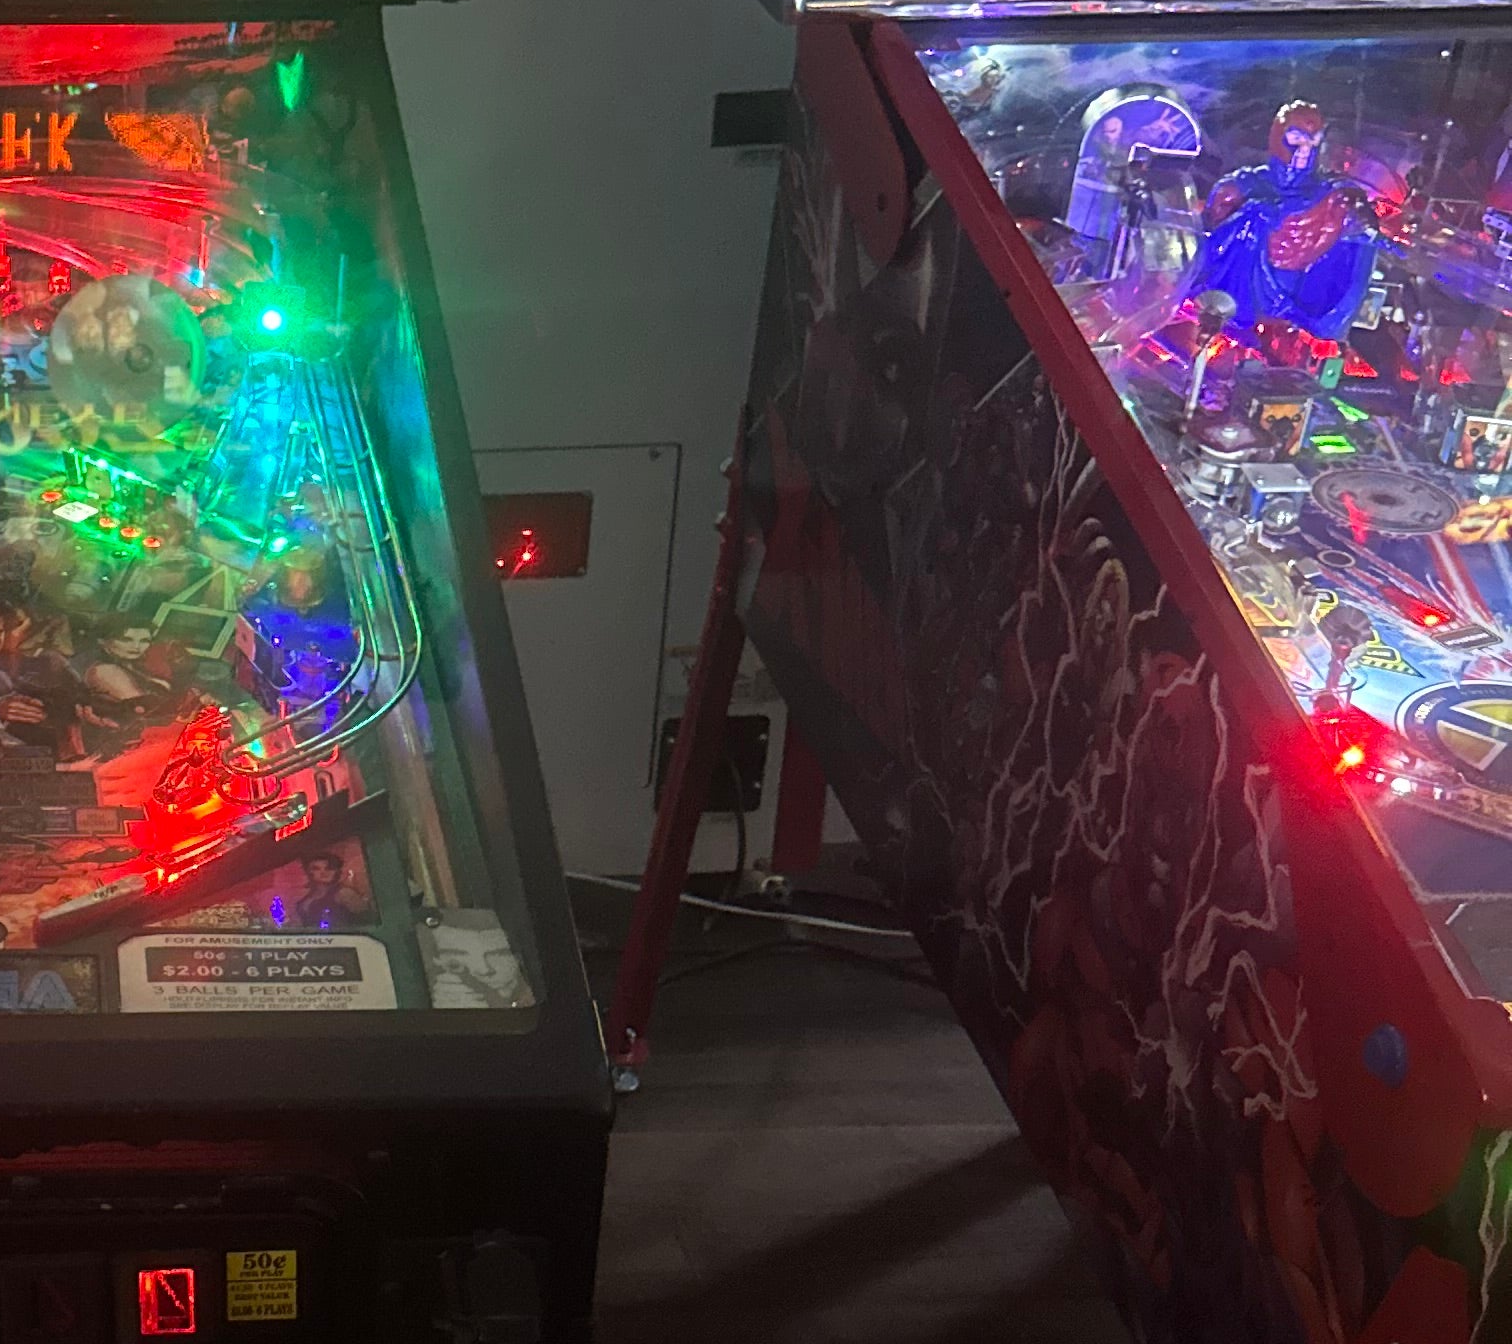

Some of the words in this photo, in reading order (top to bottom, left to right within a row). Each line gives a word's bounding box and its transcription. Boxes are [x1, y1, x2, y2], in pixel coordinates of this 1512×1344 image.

[164, 937, 195, 945] FOR
[198, 936, 291, 945] AMUSEMENT
[296, 937, 335, 945] ONLY
[261, 951, 309, 961] PLAY
[162, 965, 224, 977] $2.00
[267, 965, 346, 977] PLAYS
[153, 986, 166, 995] 3
[176, 985, 238, 995] BALLS
[249, 985, 290, 995] PER
[301, 984, 361, 995] GAME
[243, 1253, 287, 1270] 50¢
